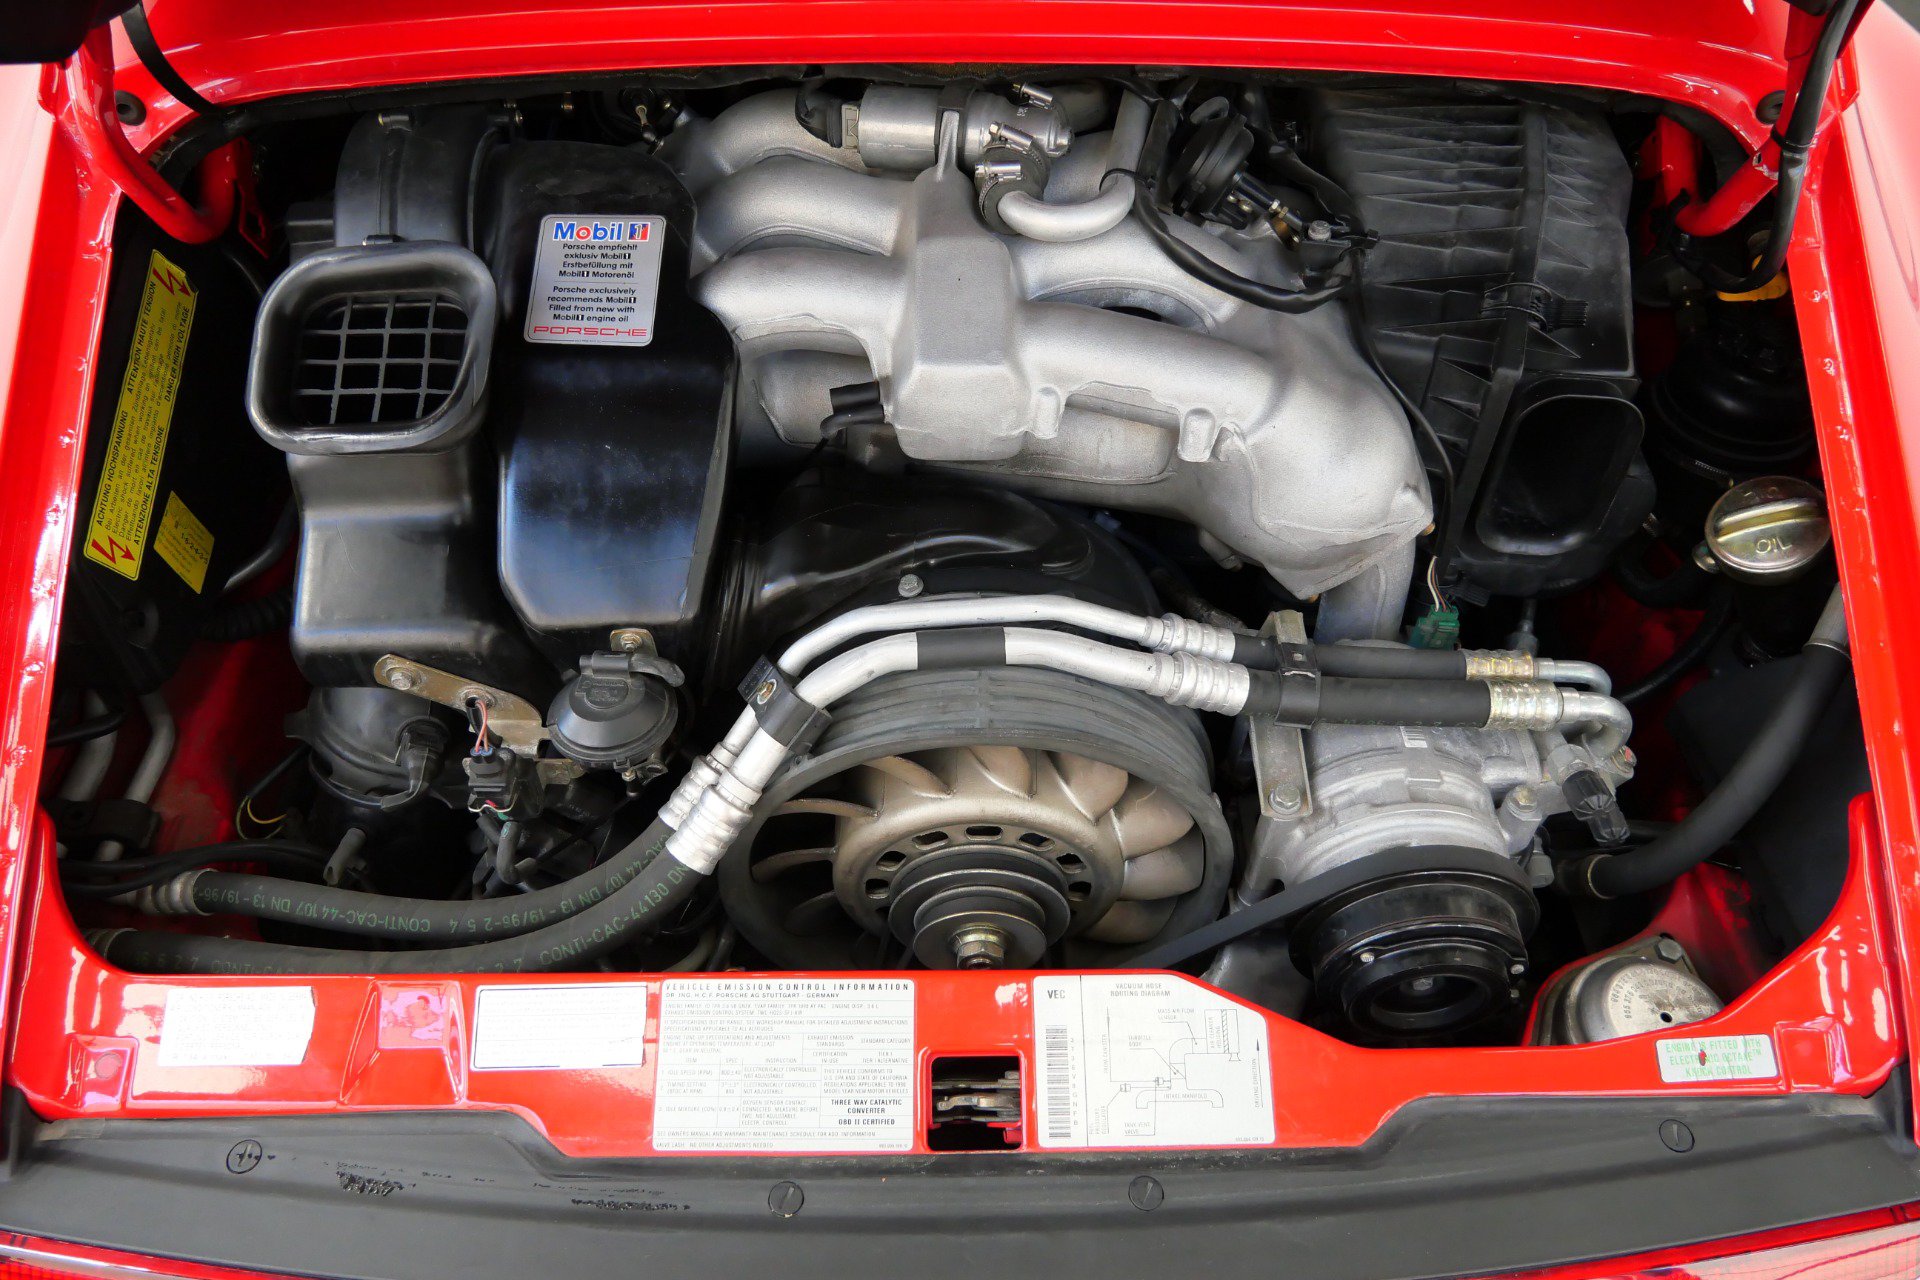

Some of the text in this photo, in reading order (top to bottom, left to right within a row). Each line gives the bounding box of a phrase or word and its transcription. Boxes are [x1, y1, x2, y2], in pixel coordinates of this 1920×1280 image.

[553, 222, 650, 241] Mobil 1
[597, 243, 638, 251] empfiehlt
[562, 261, 617, 270] Erstbefüllung
[591, 270, 635, 278] Motorenöl
[553, 286, 636, 295] Porsche exclusively
[547, 295, 603, 303] recommends
[549, 304, 572, 312] Filled
[617, 305, 635, 313] with
[586, 315, 616, 323] engine
[533, 326, 647, 337] PORSCHE
[96, 281, 156, 526] ACHTUNG HOCHSPANNUNG ATTENTION HAUTE TENSION
[133, 306, 189, 545] ATTENZIONE ALTA TENSIONE DANGER HIGH VOLTAGE
[119, 481, 128, 502] shock
[1755, 537, 1793, 555] OIL
[252, 894, 267, 907] 13
[578, 886, 600, 906] DN
[271, 896, 291, 913] DN
[560, 898, 576, 914] 13
[665, 983, 909, 991] VEHICLE EMISSION CONTROL INFORMATION
[1047, 989, 1066, 999] VEC
[1709, 1039, 1738, 1050] FITTED
